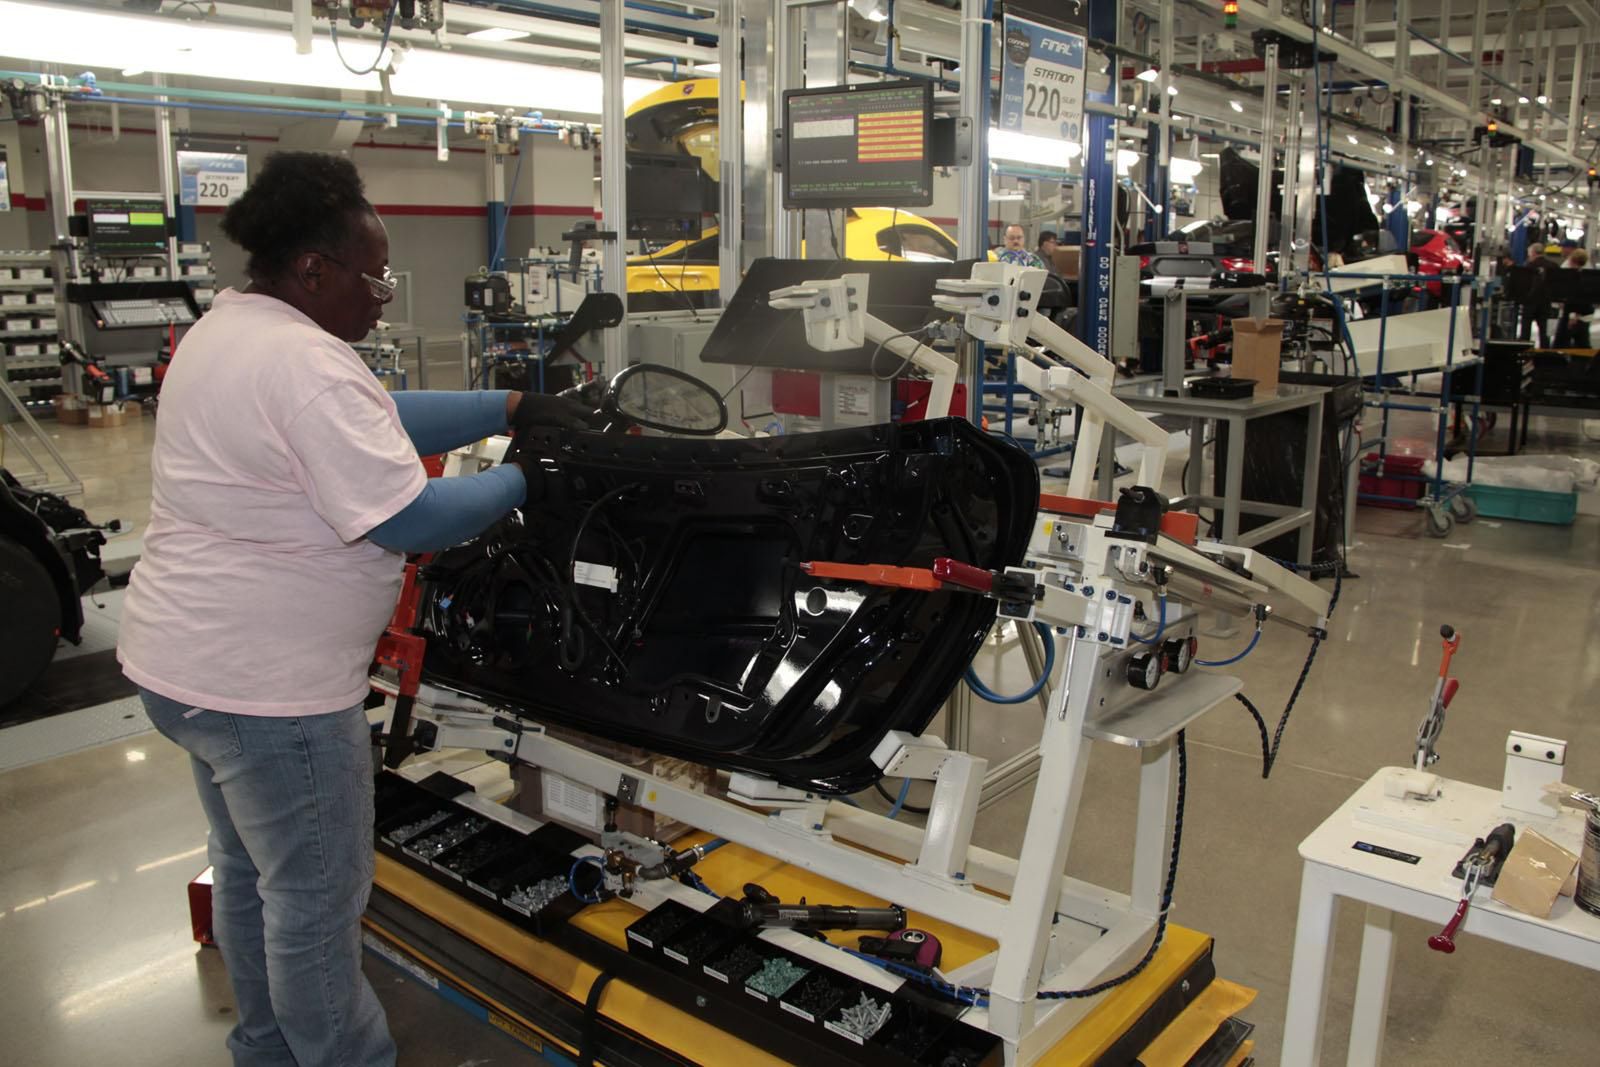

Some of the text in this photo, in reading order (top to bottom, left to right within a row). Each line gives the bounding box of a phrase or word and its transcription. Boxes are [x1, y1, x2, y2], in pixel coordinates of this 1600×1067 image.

[1040, 38, 1072, 56] FINAL
[1033, 67, 1075, 84] STATION
[1025, 83, 1060, 121] 220
[199, 182, 229, 198] 220
[1099, 256, 1109, 269] DO
[1099, 274, 1109, 292] NOT
[1098, 297, 1108, 321] OPEN
